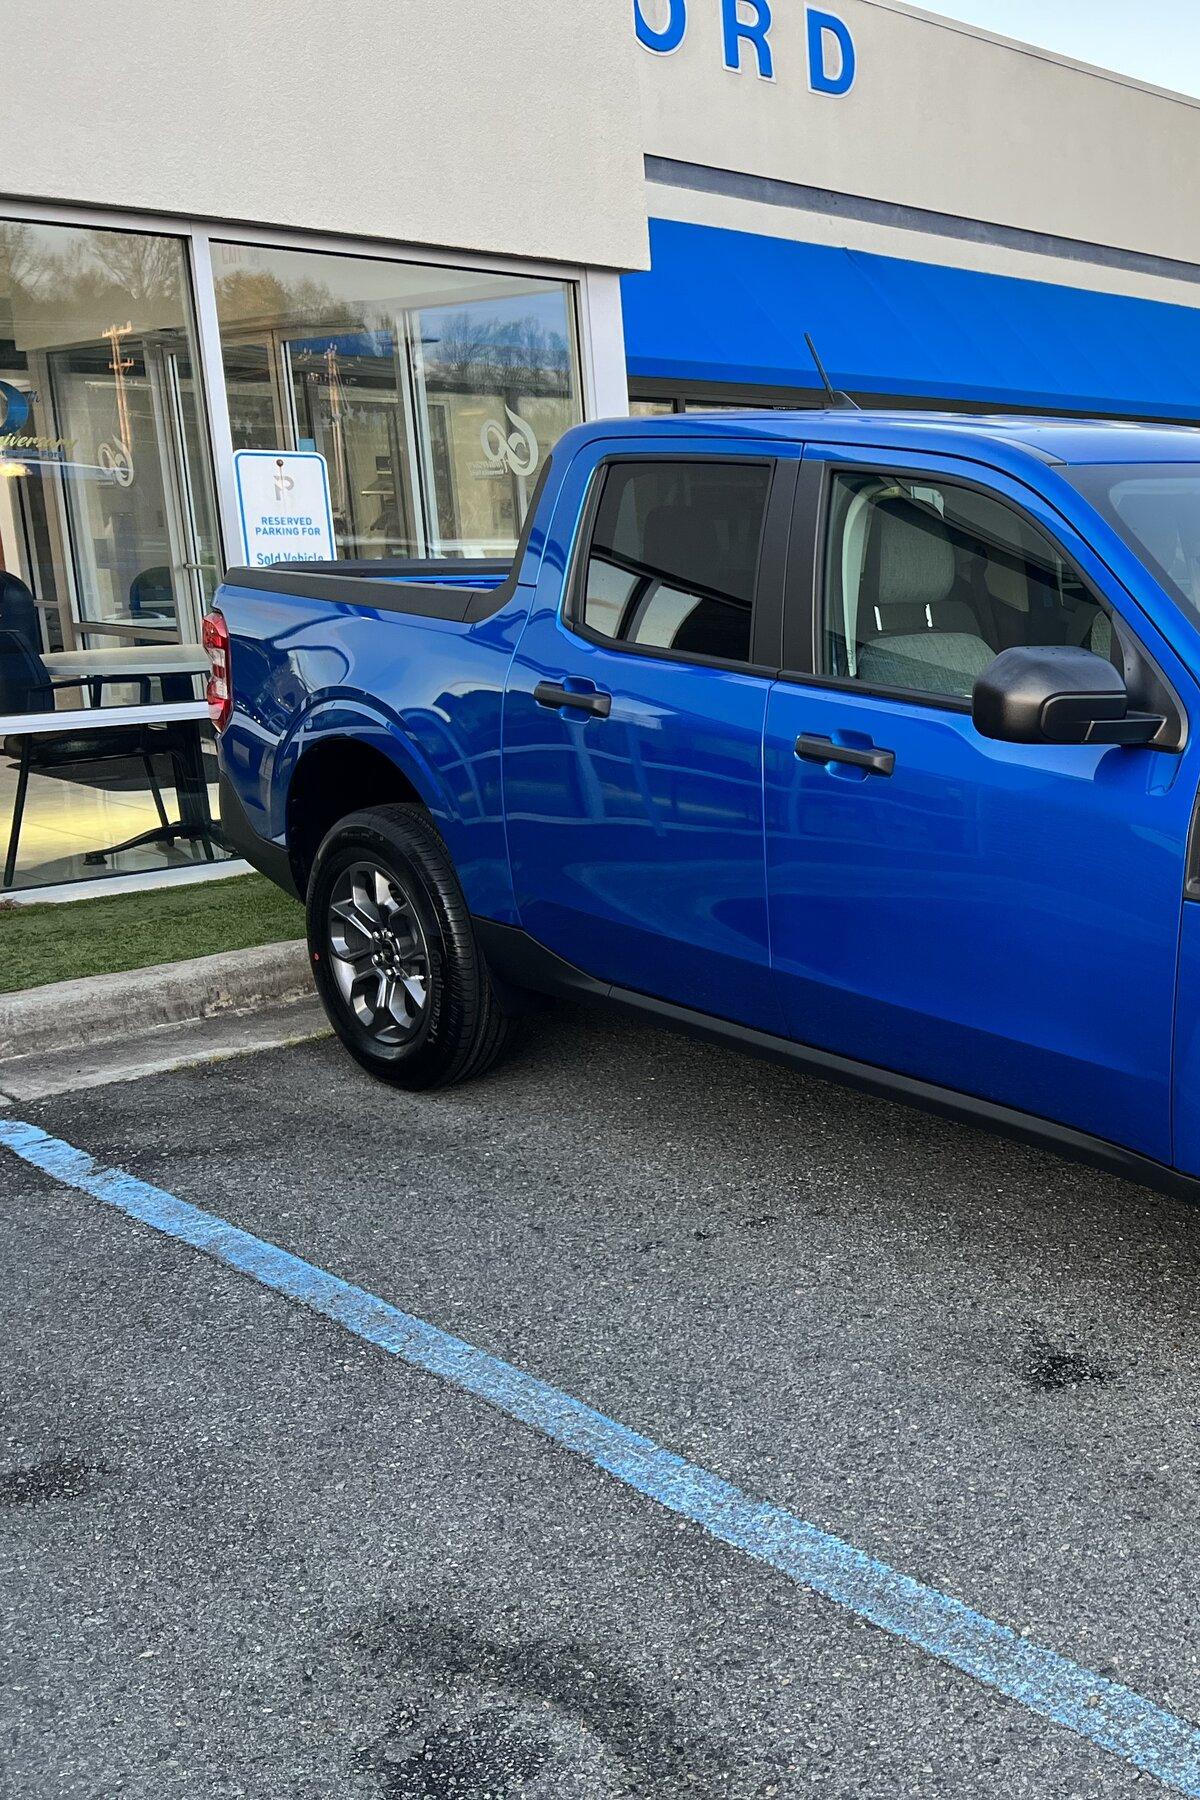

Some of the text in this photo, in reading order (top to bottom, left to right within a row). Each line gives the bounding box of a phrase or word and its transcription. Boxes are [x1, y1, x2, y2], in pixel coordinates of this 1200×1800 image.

[261, 516, 313, 526] RESERVED
[255, 527, 321, 536] PARKING FOR
[256, 552, 281, 565] Sold
